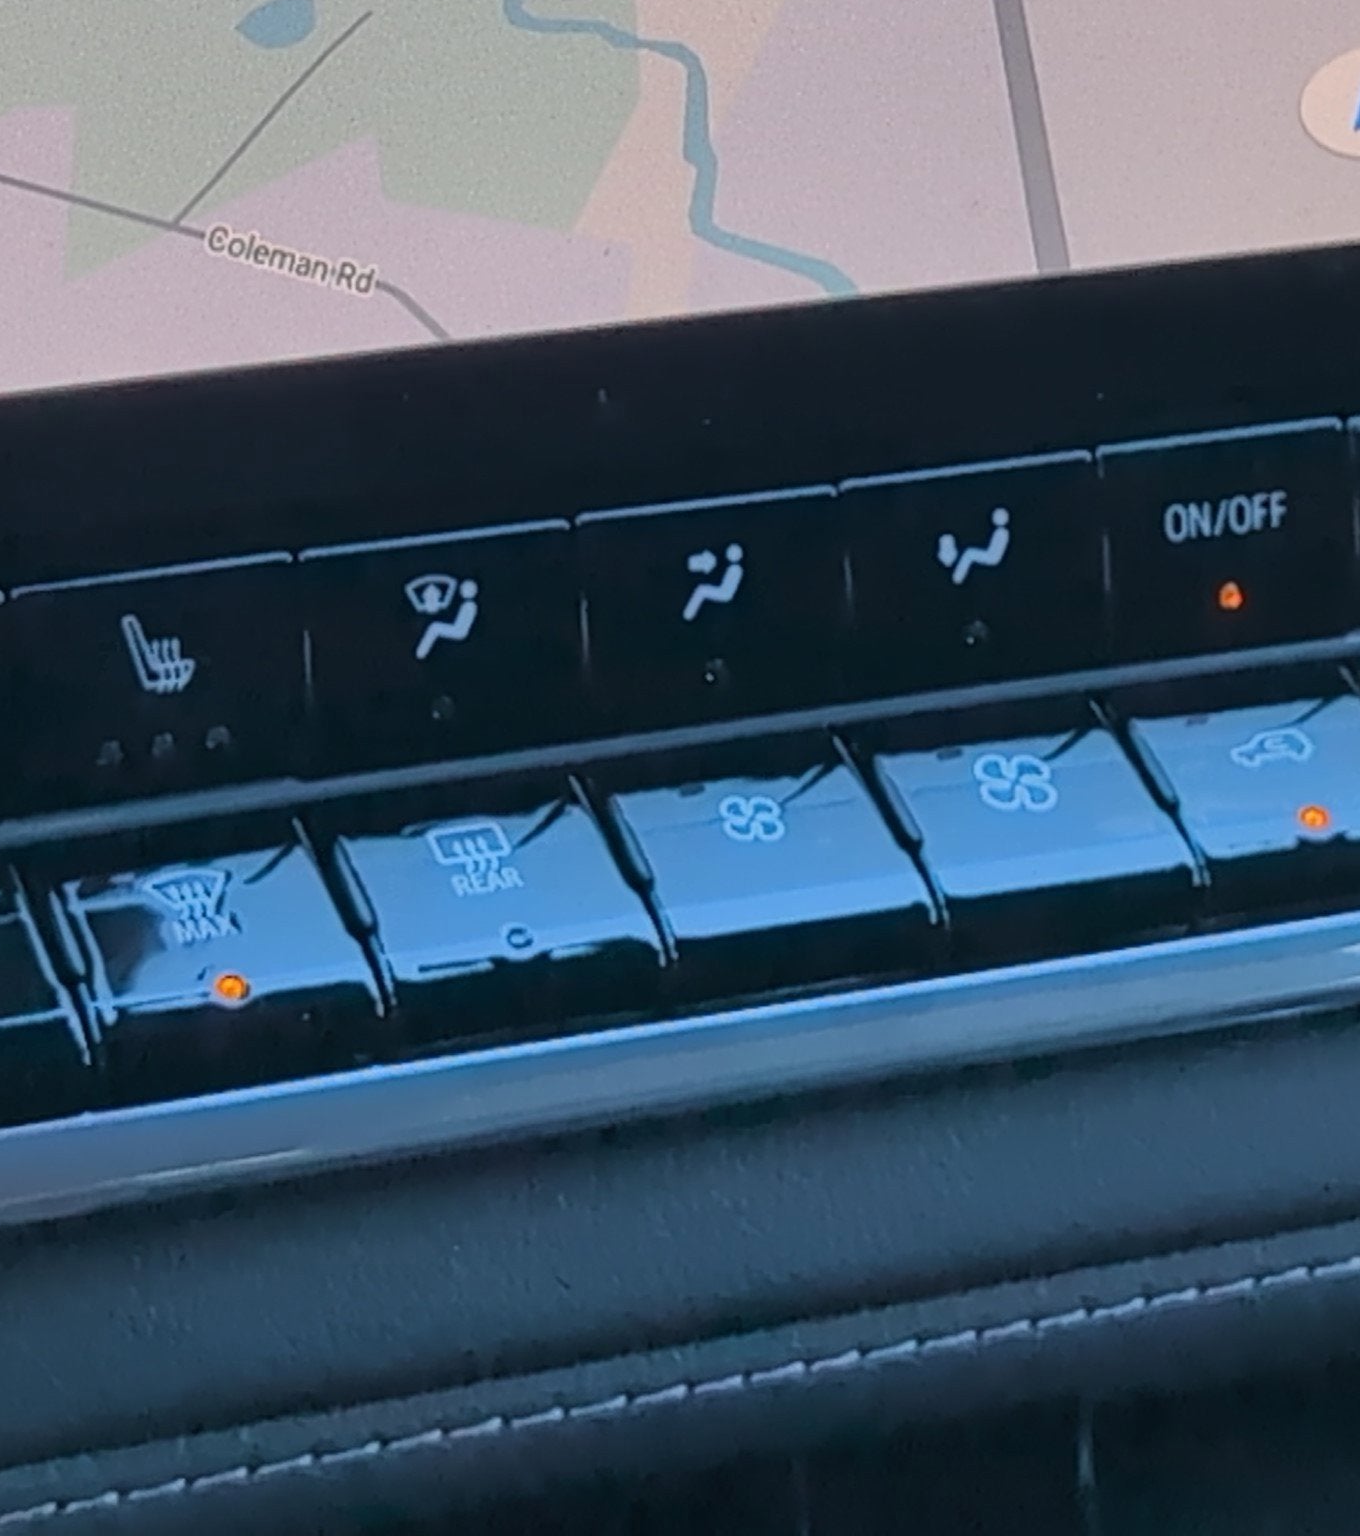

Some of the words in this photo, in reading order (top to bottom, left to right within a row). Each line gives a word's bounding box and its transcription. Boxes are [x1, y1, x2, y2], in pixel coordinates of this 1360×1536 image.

[207, 225, 330, 283] Coleman
[335, 261, 376, 295] Rd
[1164, 489, 1287, 544] ON/OFF
[451, 866, 524, 898] REAR
[173, 911, 239, 944] MAX
